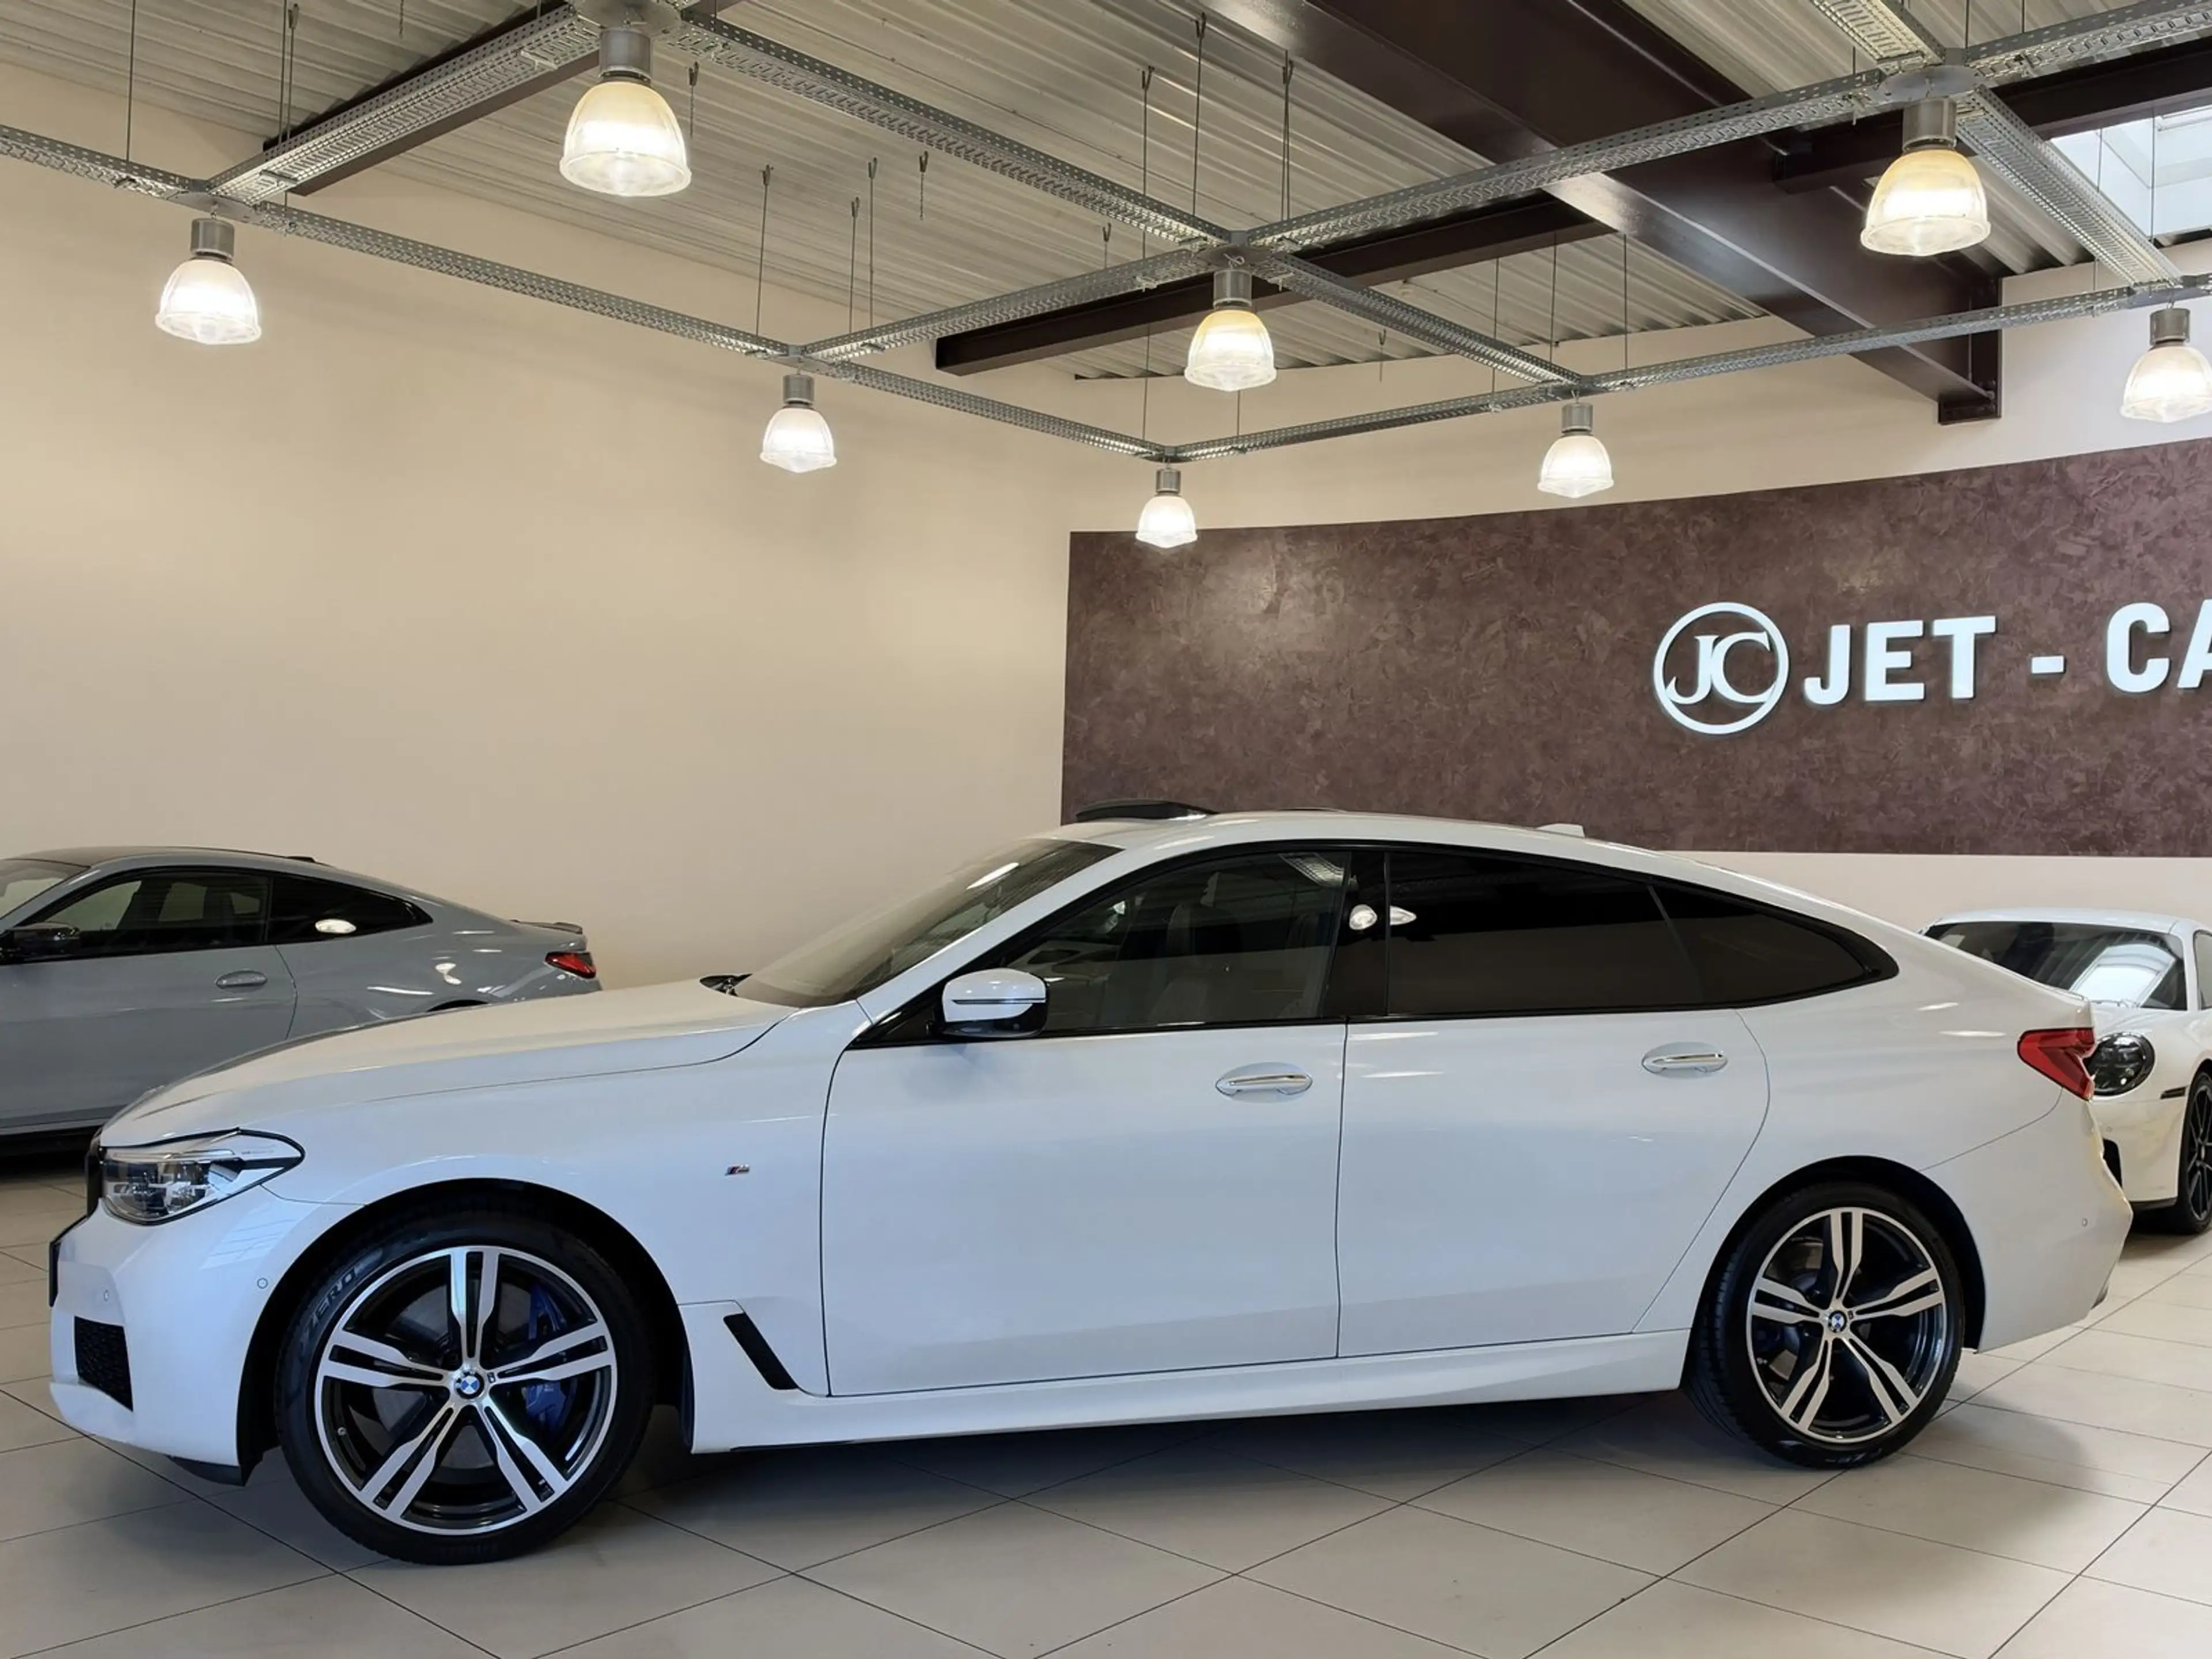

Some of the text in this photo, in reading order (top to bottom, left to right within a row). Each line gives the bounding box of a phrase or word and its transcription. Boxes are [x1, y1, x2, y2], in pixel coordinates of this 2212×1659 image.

[1665, 631, 1777, 704] JC
[1804, 616, 1995, 704] JET
[2032, 656, 2065, 673] -
[306, 1267, 357, 1341] ZERO
